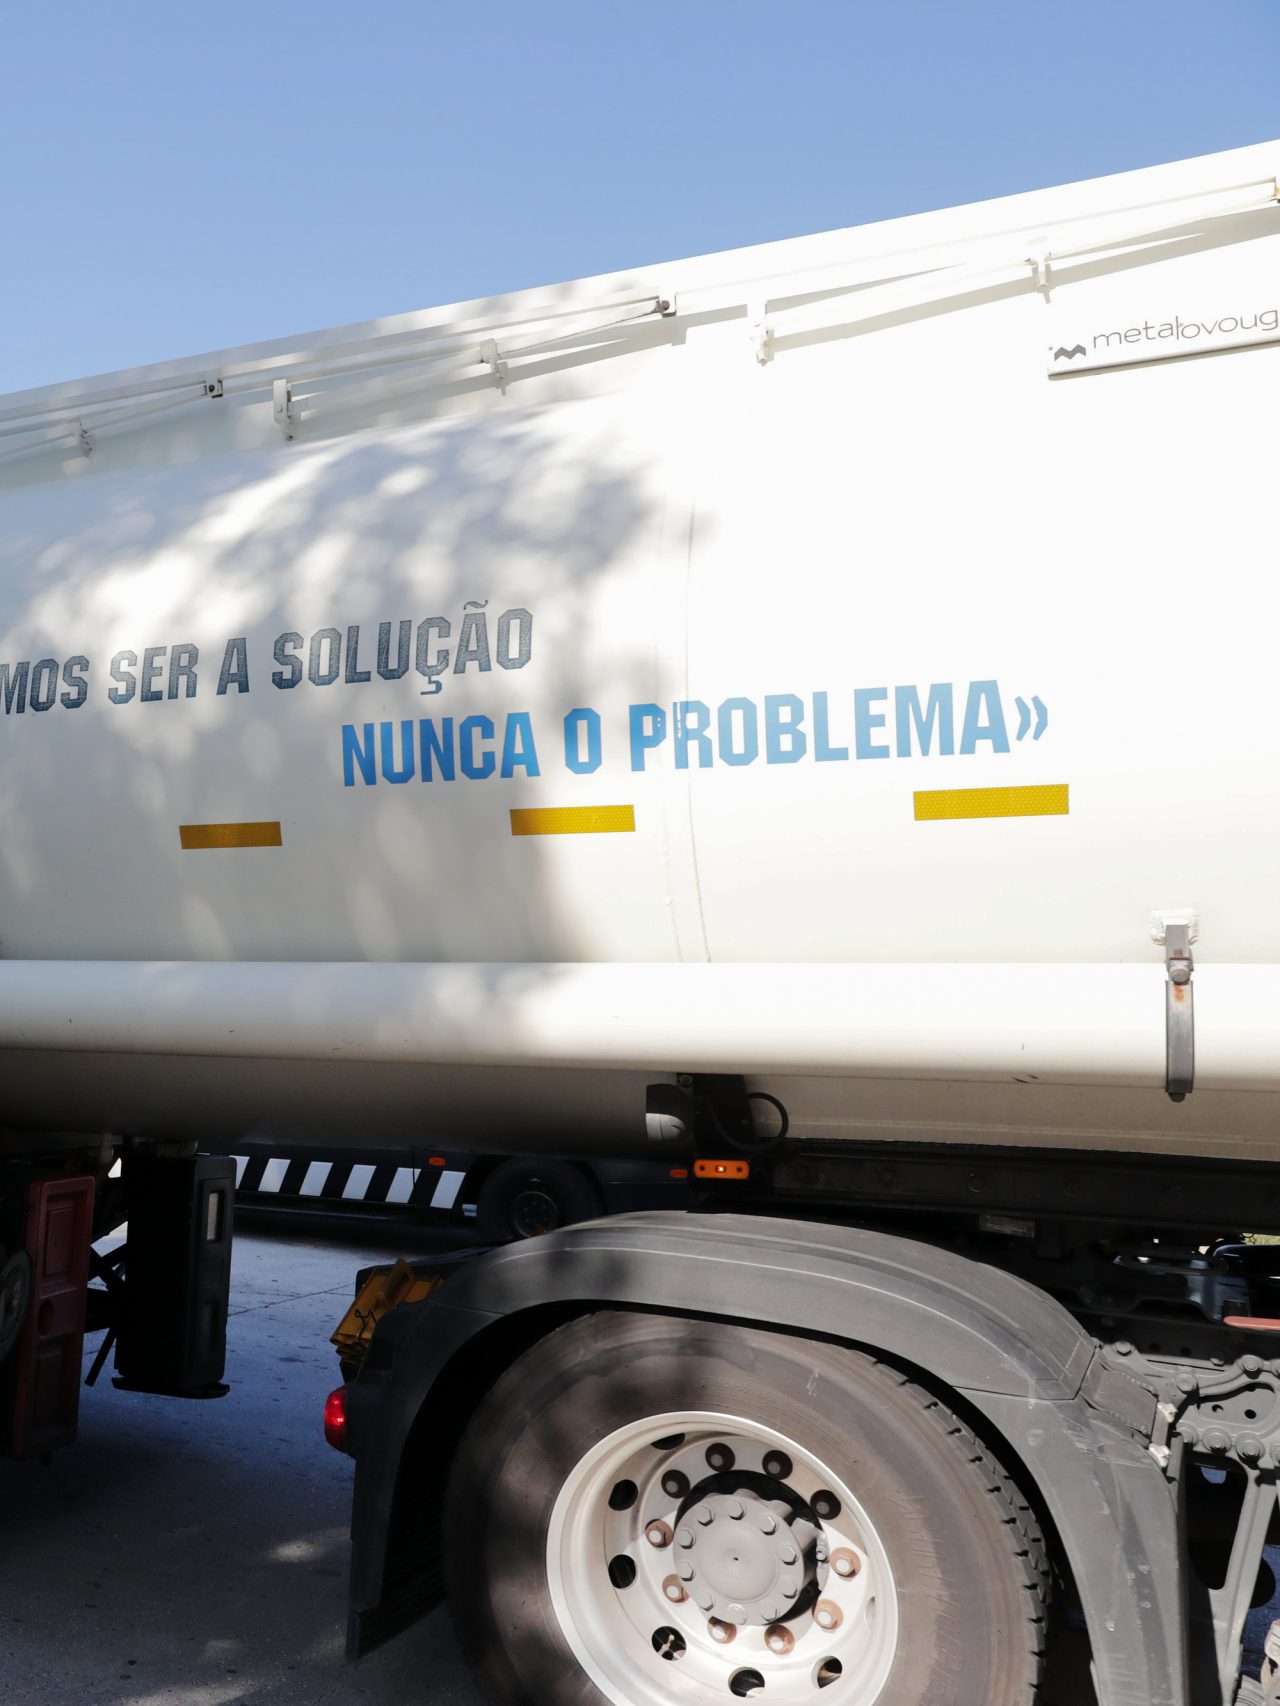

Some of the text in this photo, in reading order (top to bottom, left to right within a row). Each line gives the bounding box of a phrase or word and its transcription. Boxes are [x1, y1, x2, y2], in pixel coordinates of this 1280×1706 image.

[107, 642, 199, 706] SER
[216, 637, 251, 696] A
[271, 600, 533, 696] SOLUÇÃO
[341, 679, 1049, 787] NUNCA O PROBLEMA»
